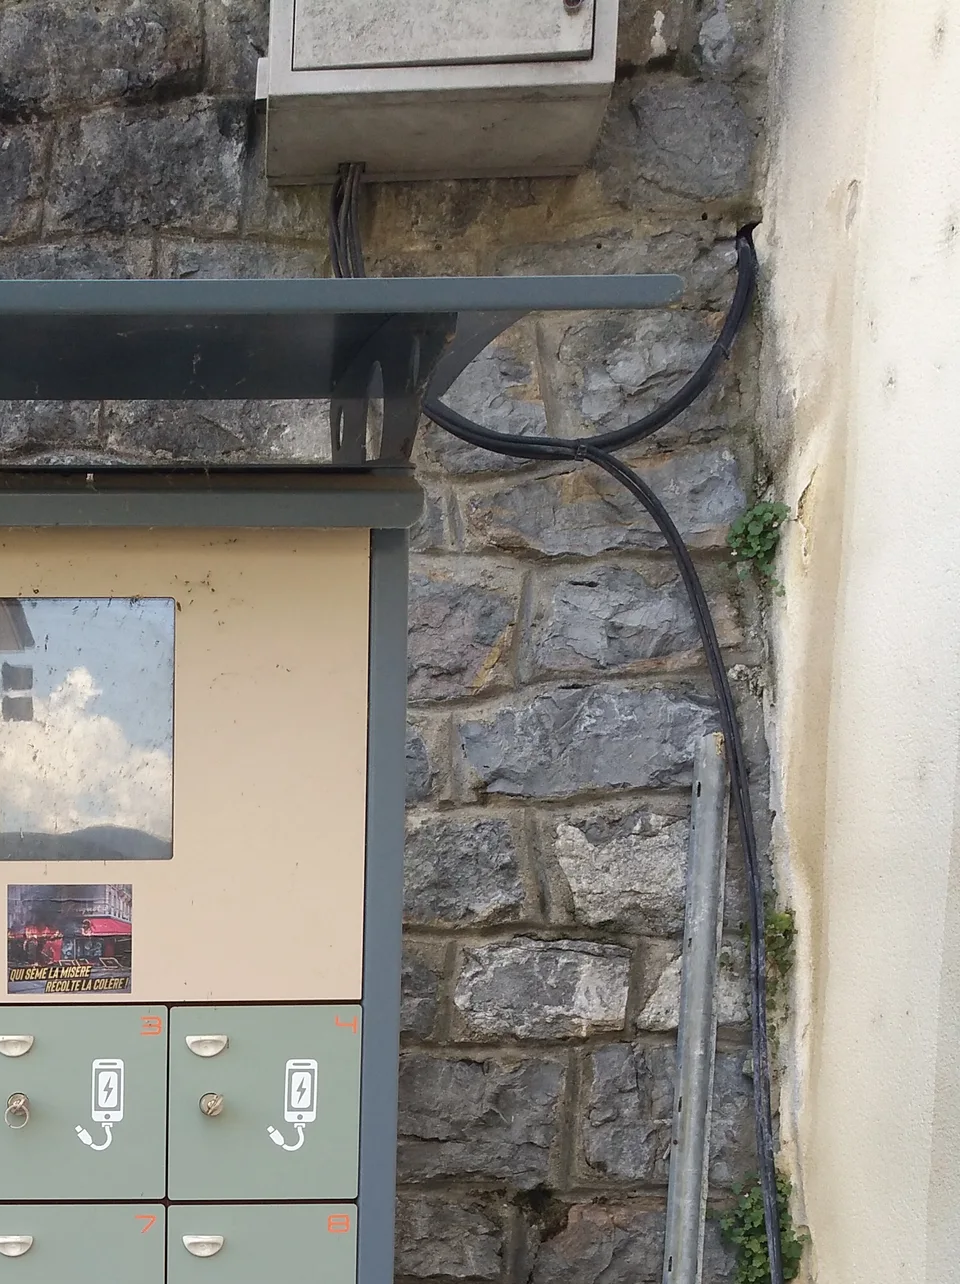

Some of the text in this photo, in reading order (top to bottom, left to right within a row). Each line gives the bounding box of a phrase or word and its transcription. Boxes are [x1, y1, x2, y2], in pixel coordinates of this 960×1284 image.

[9, 968, 24, 981] QUI
[48, 967, 59, 979] LA
[81, 979, 92, 991] LA
[140, 1015, 163, 1037] 3
[334, 1015, 358, 1035] 4
[135, 1214, 157, 1234] 7
[327, 1213, 351, 1234] 8
